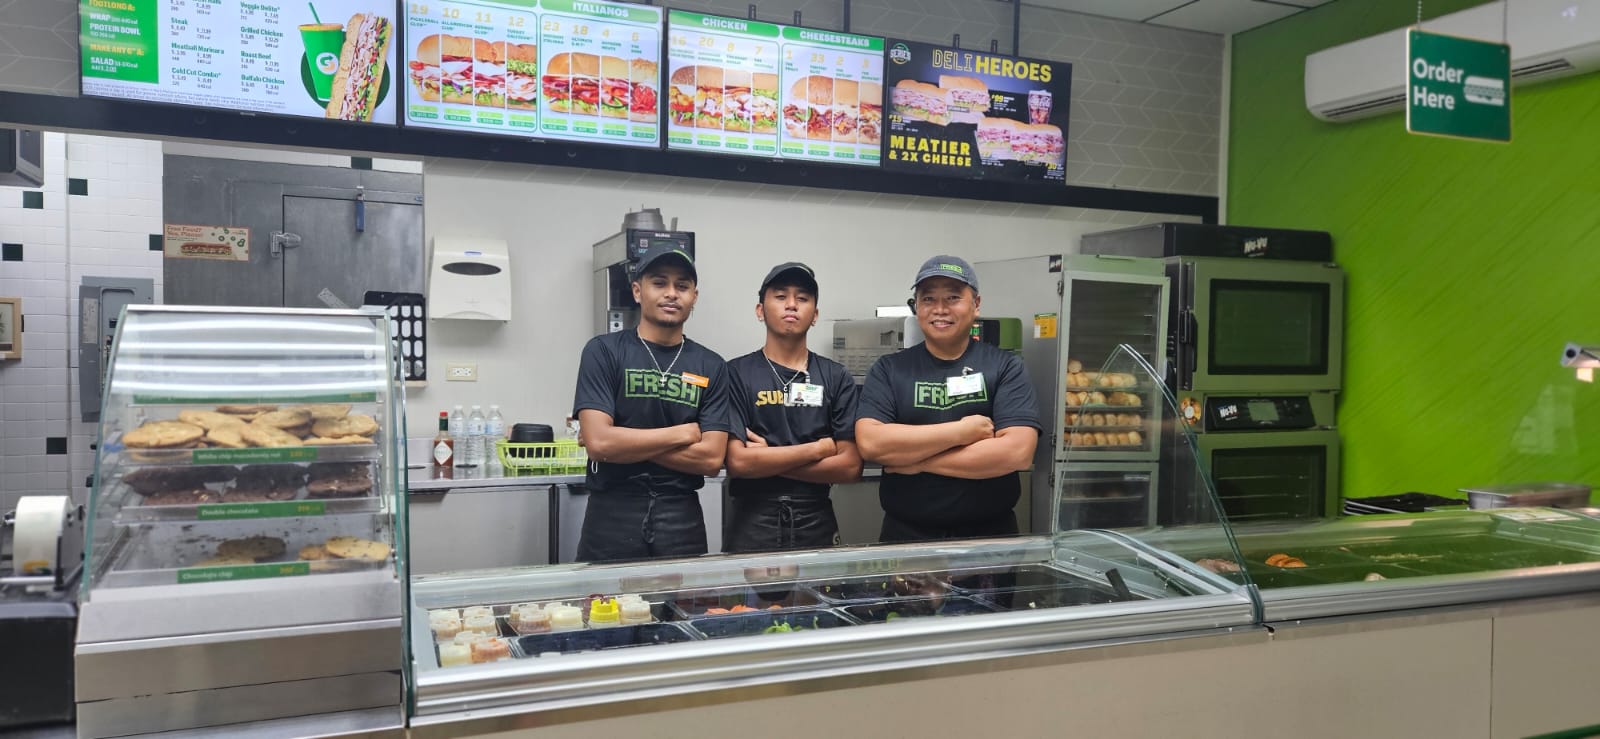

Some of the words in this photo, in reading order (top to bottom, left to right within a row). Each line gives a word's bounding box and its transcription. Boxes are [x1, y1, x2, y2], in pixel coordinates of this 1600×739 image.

[411, 3, 428, 15] 19
[443, 7, 460, 19] 10
[573, 2, 629, 17] ITALIANOS
[90, 13, 110, 22] WRAP
[171, 17, 188, 25] Steak
[475, 11, 491, 23] 11
[508, 15, 524, 27] 12
[90, 23, 120, 33] PROTEIN
[121, 27, 141, 36] BOWL
[702, 17, 748, 32] CHICKEN
[241, 26, 260, 35] Grilled
[261, 29, 284, 38] Chicken
[800, 30, 870, 48] CHEESESTEAKS
[171, 42, 197, 51] Meatball
[198, 45, 225, 54] Marinara
[91, 57, 114, 66] SALAD
[932, 49, 973, 72] DELI
[975, 54, 1053, 83] HEROES
[1413, 58, 1464, 84] Order
[241, 74, 261, 82] Buffalo
[262, 76, 285, 85] Chicken
[1413, 85, 1455, 110] Here
[890, 135, 971, 156] MEATIER
[888, 150, 898, 161] &
[901, 151, 918, 163] 2X
[922, 152, 972, 167] CHEESE
[202, 508, 225, 516] Double
[226, 506, 259, 515] chocolate
